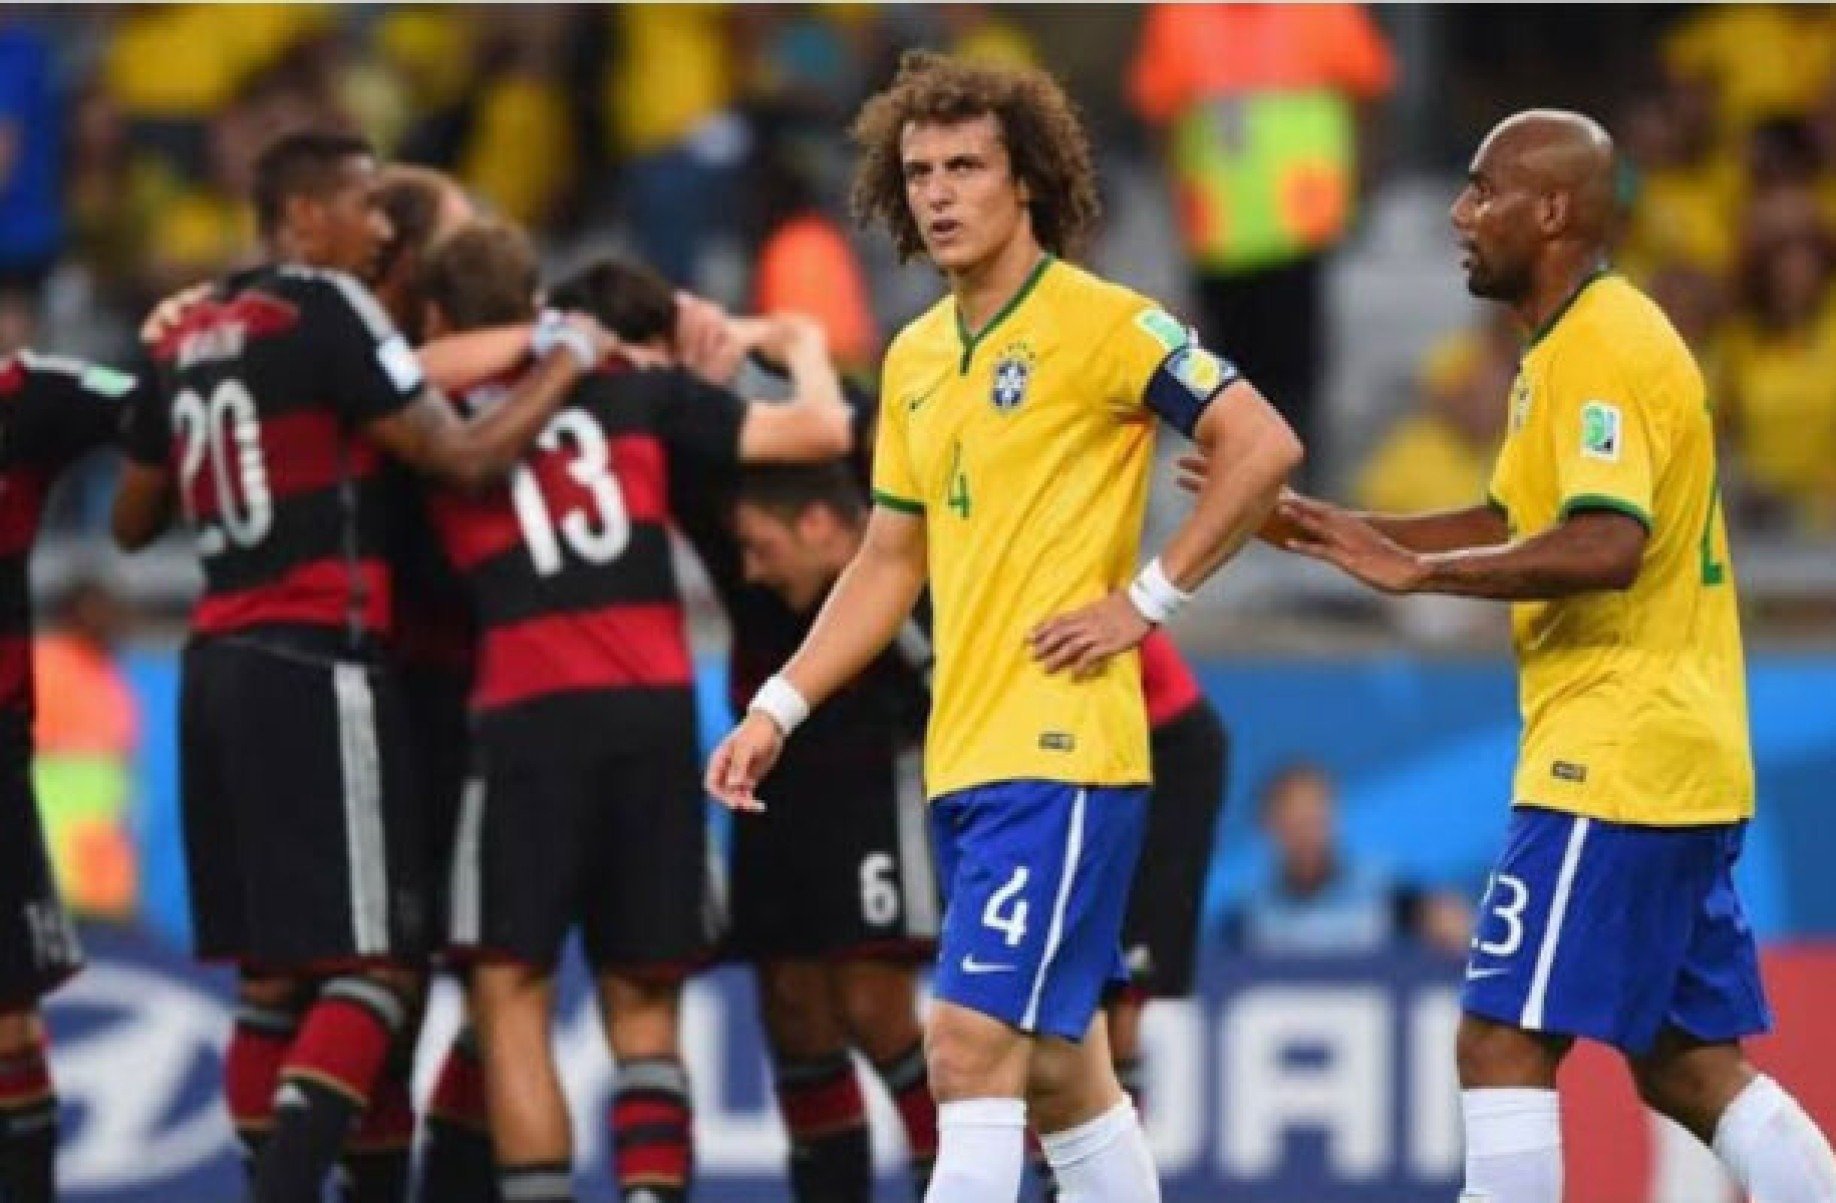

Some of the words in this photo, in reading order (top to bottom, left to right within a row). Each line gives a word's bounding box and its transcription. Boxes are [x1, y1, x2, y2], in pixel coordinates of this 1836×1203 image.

[172, 379, 274, 552] 20
[511, 409, 631, 577] 13
[946, 441, 971, 519] 4
[860, 853, 898, 924] 6
[983, 866, 1028, 946] 4
